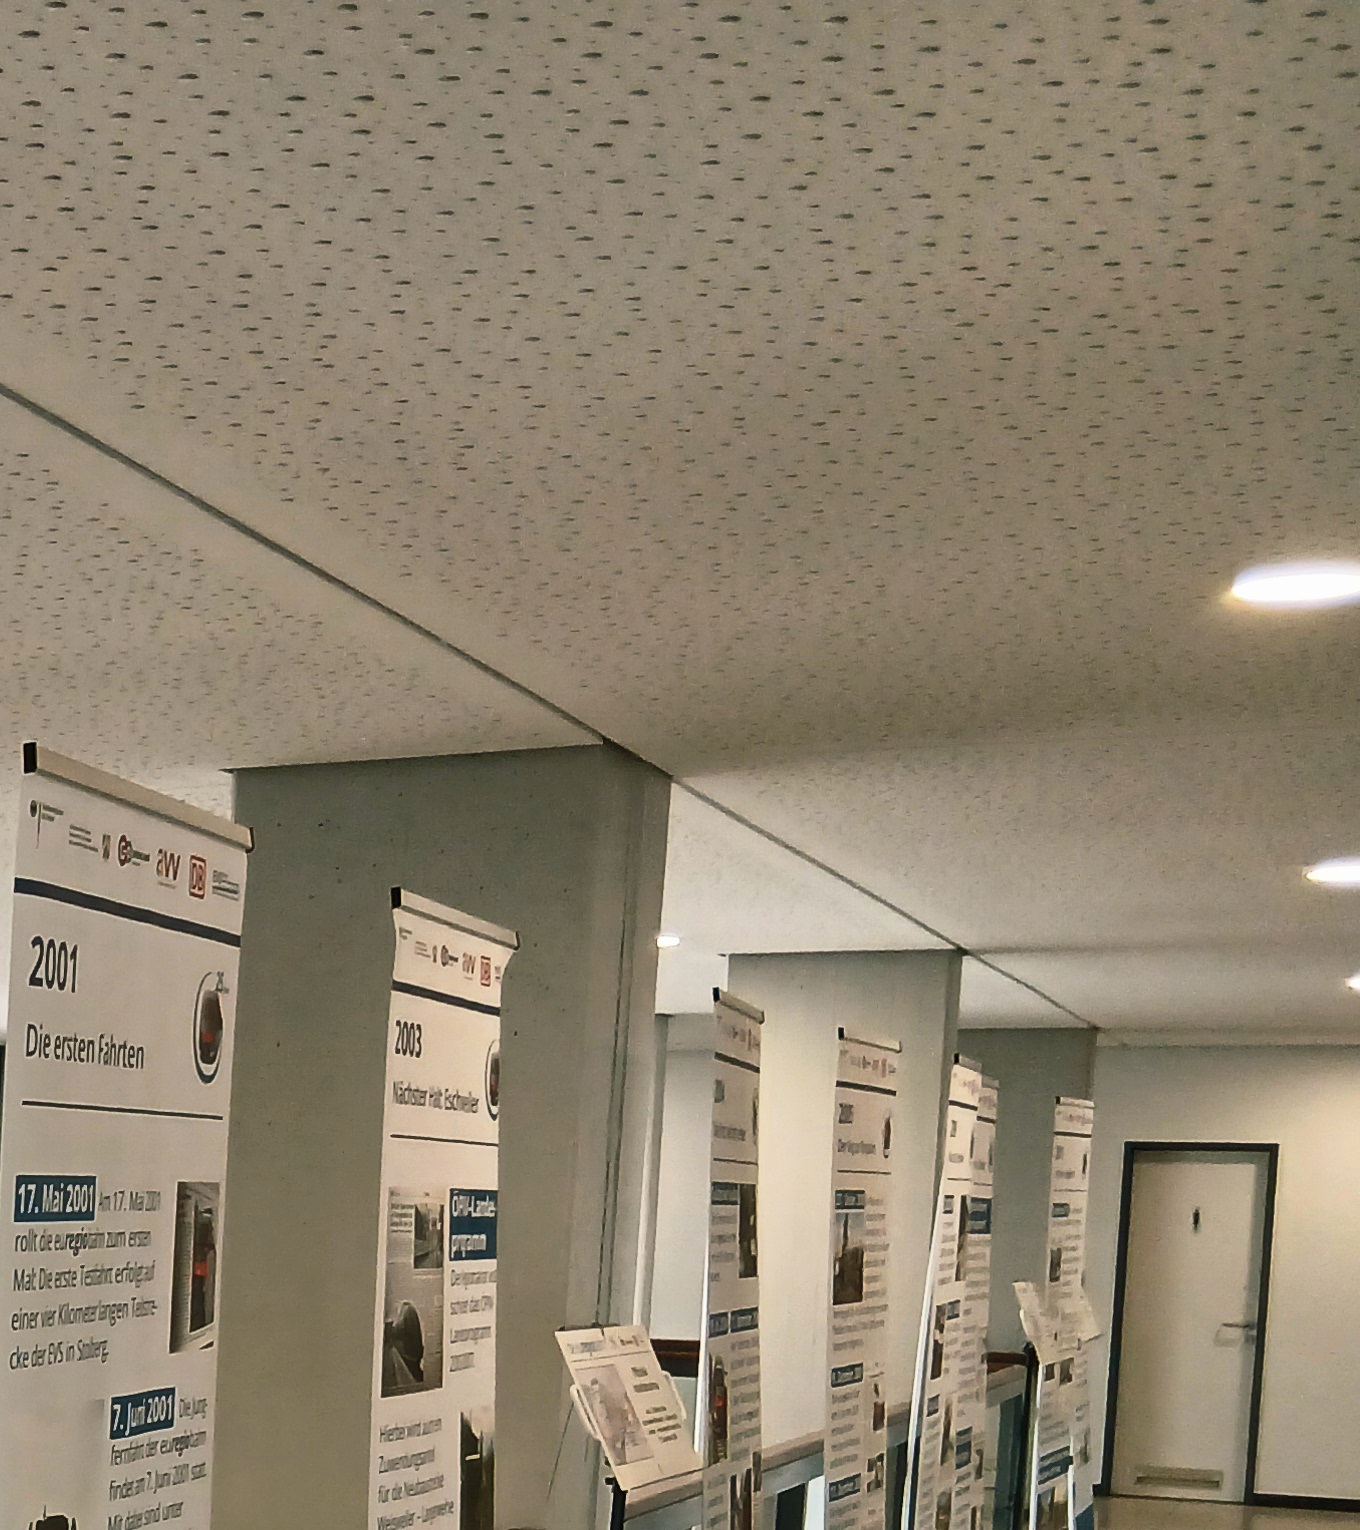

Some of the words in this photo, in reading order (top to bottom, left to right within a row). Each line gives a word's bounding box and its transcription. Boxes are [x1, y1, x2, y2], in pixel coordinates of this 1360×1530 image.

[190, 859, 206, 895] DB
[28, 935, 79, 993] 2001
[25, 1023, 52, 1060] Die
[54, 1031, 96, 1065] ersten
[394, 1020, 423, 1058] 2003
[18, 1183, 40, 1215] 17.
[42, 1183, 64, 1213] Mai
[66, 1183, 95, 1213] 2001
[114, 1189, 128, 1212] 17.
[15, 1228, 38, 1252] rollt
[106, 1230, 126, 1249] zum
[11, 1306, 39, 1330] einer
[9, 1345, 29, 1370] cke
[31, 1344, 47, 1367] der
[48, 1342, 63, 1366] EVS
[65, 1341, 75, 1362] in
[112, 1403, 124, 1431] 7.
[124, 1398, 146, 1436] Juni
[147, 1395, 173, 1424] 2001
